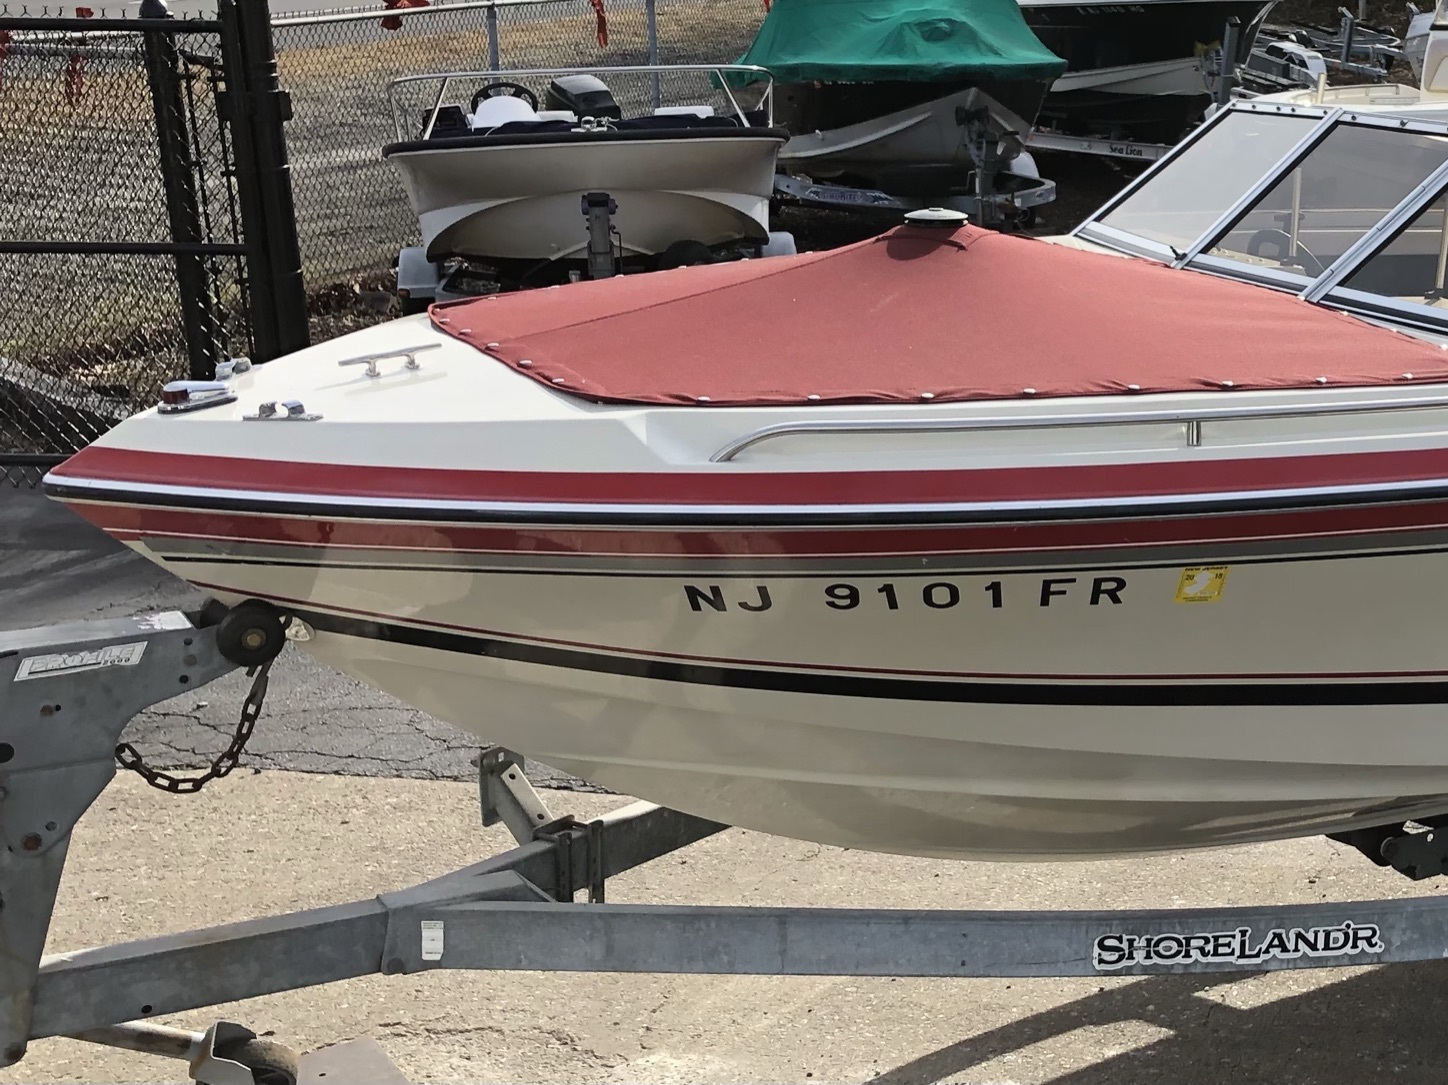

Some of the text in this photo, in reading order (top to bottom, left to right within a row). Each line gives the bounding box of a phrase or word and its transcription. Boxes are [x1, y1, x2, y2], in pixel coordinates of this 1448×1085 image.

[1109, 144, 1143, 157] Sea Lion
[683, 576, 1128, 612] NJ 9101 FR
[102, 656, 131, 666] 2000
